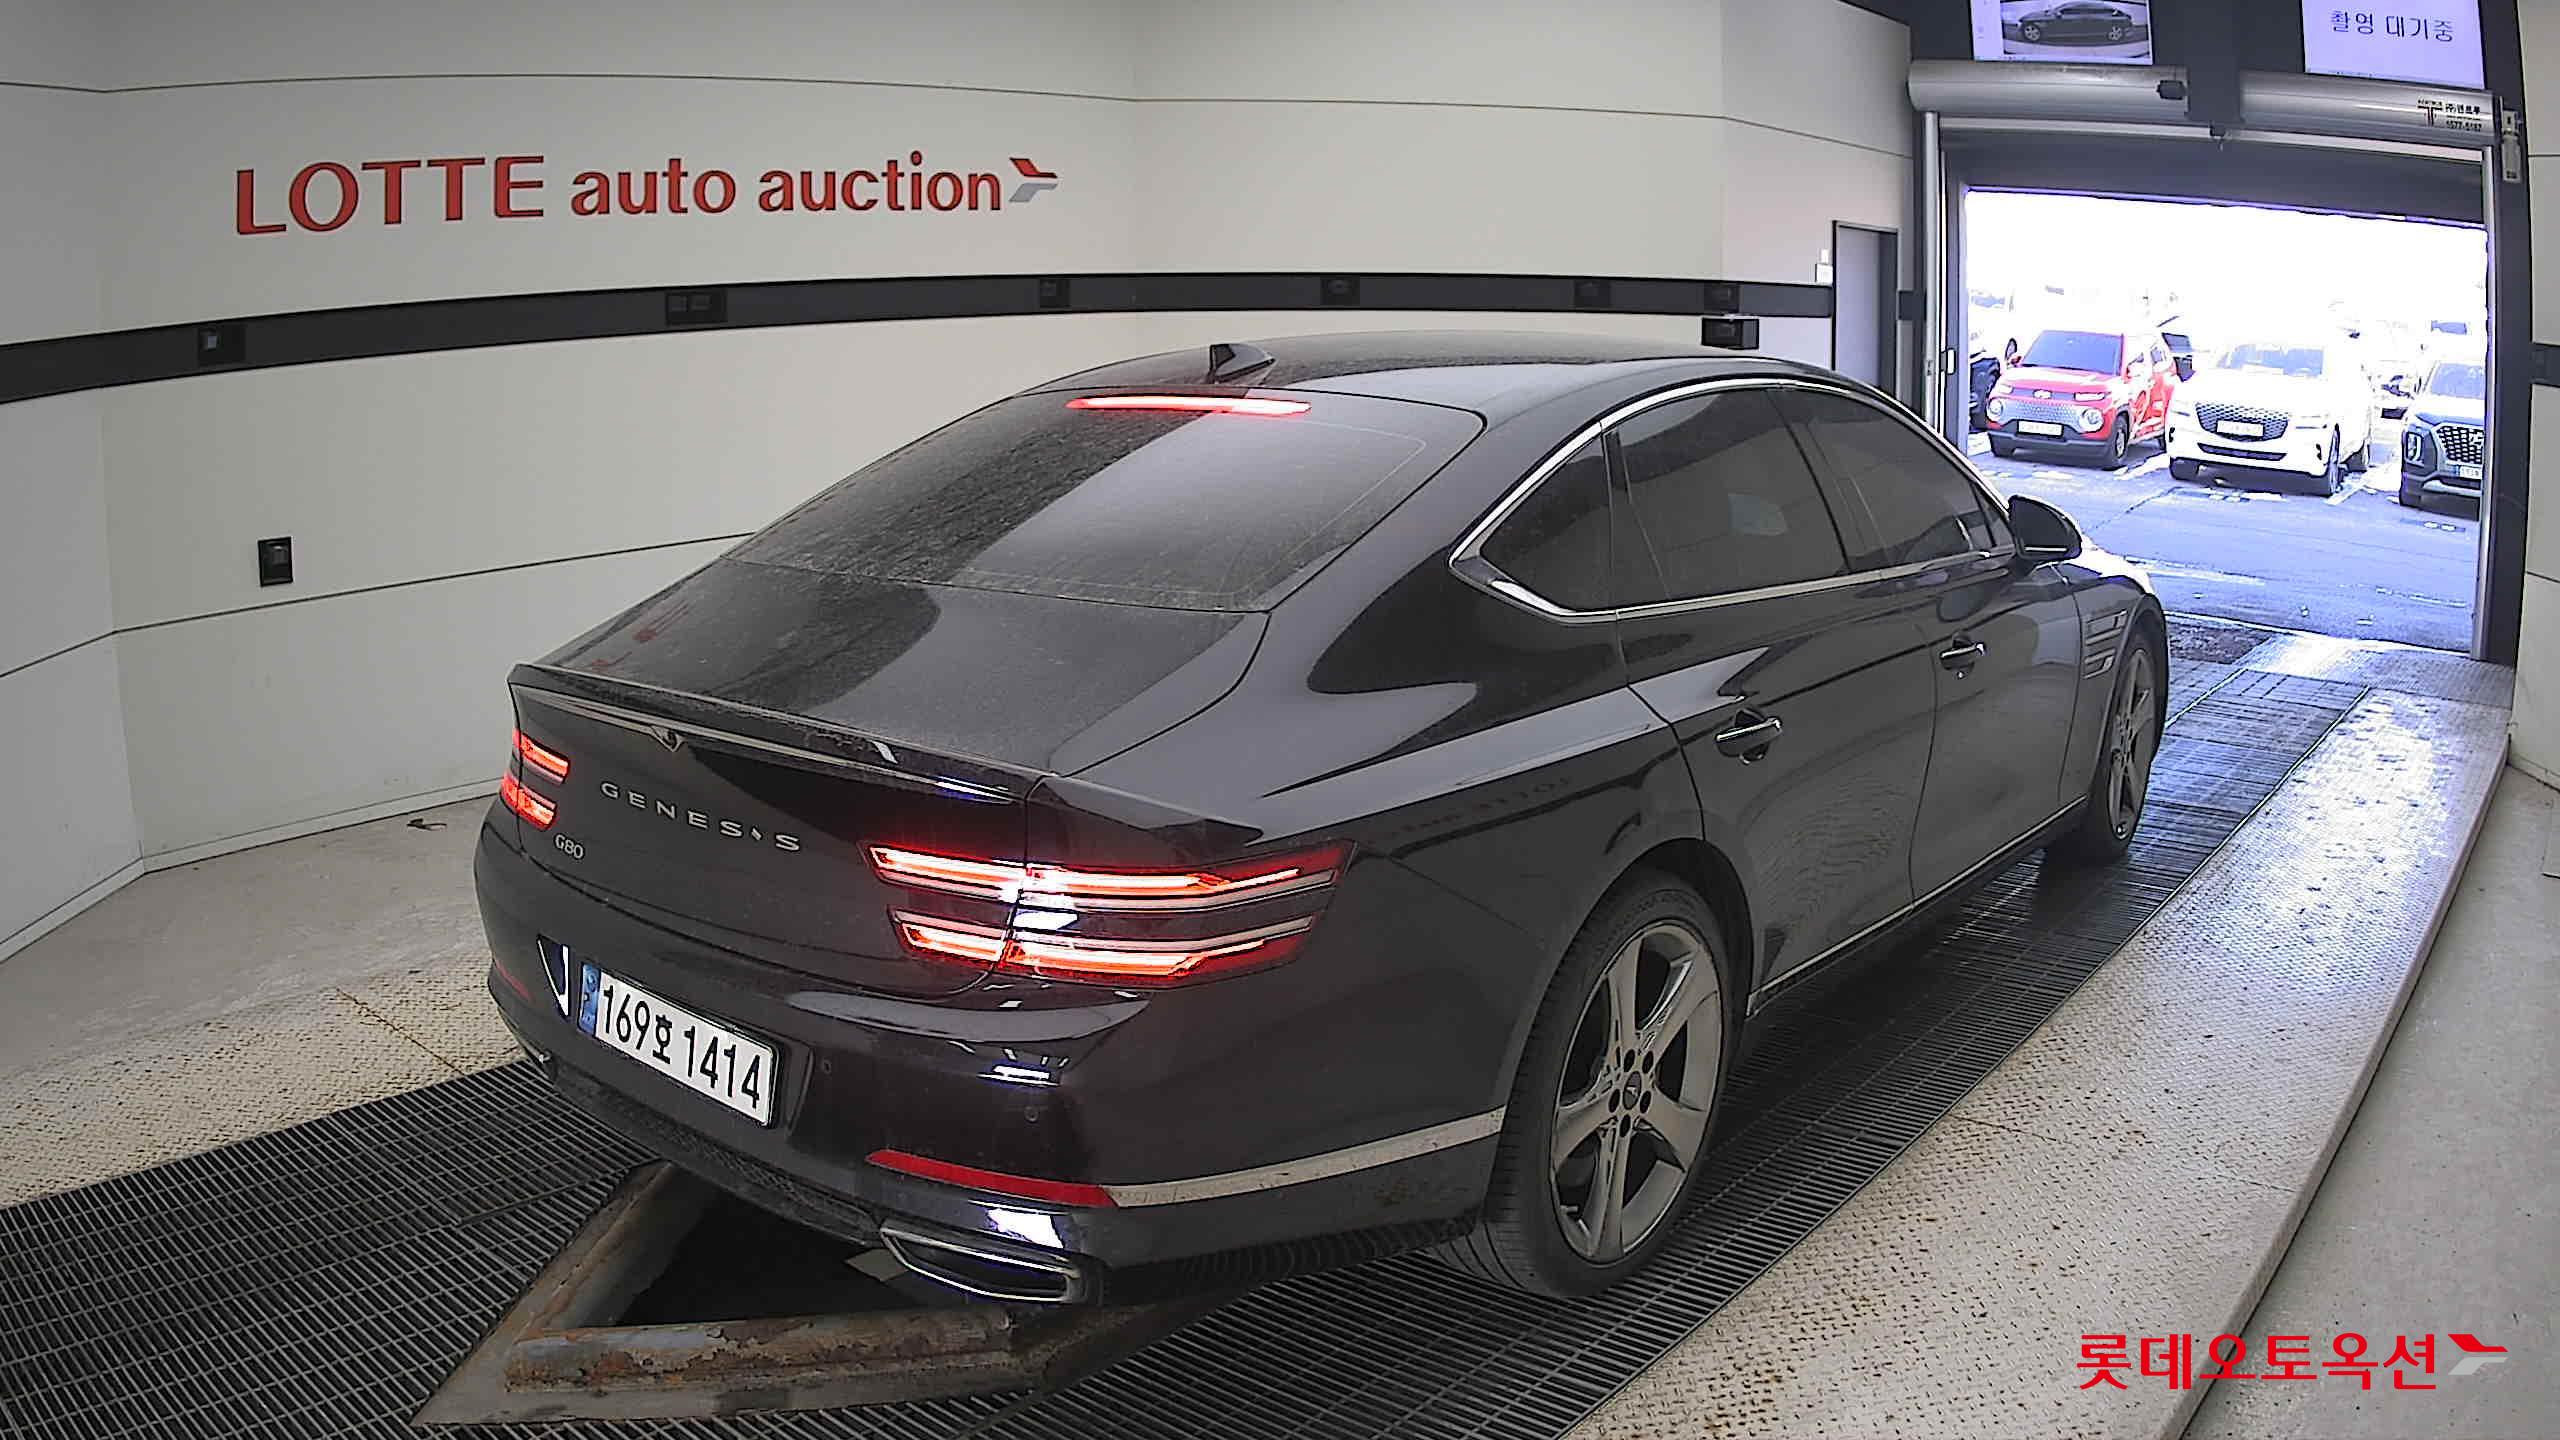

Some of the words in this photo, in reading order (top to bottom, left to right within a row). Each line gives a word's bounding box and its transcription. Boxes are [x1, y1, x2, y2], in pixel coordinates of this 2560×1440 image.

[2330, 10, 2374, 35] 촬영
[2386, 15, 2454, 42] 대기중
[236, 155, 544, 235] LOTTE
[571, 158, 736, 216] auto
[758, 150, 1003, 213] auction
[554, 834, 585, 860] G80
[600, 781, 801, 852] GENESIS
[603, 985, 673, 1065] 169호
[684, 1025, 760, 1110] 1414
